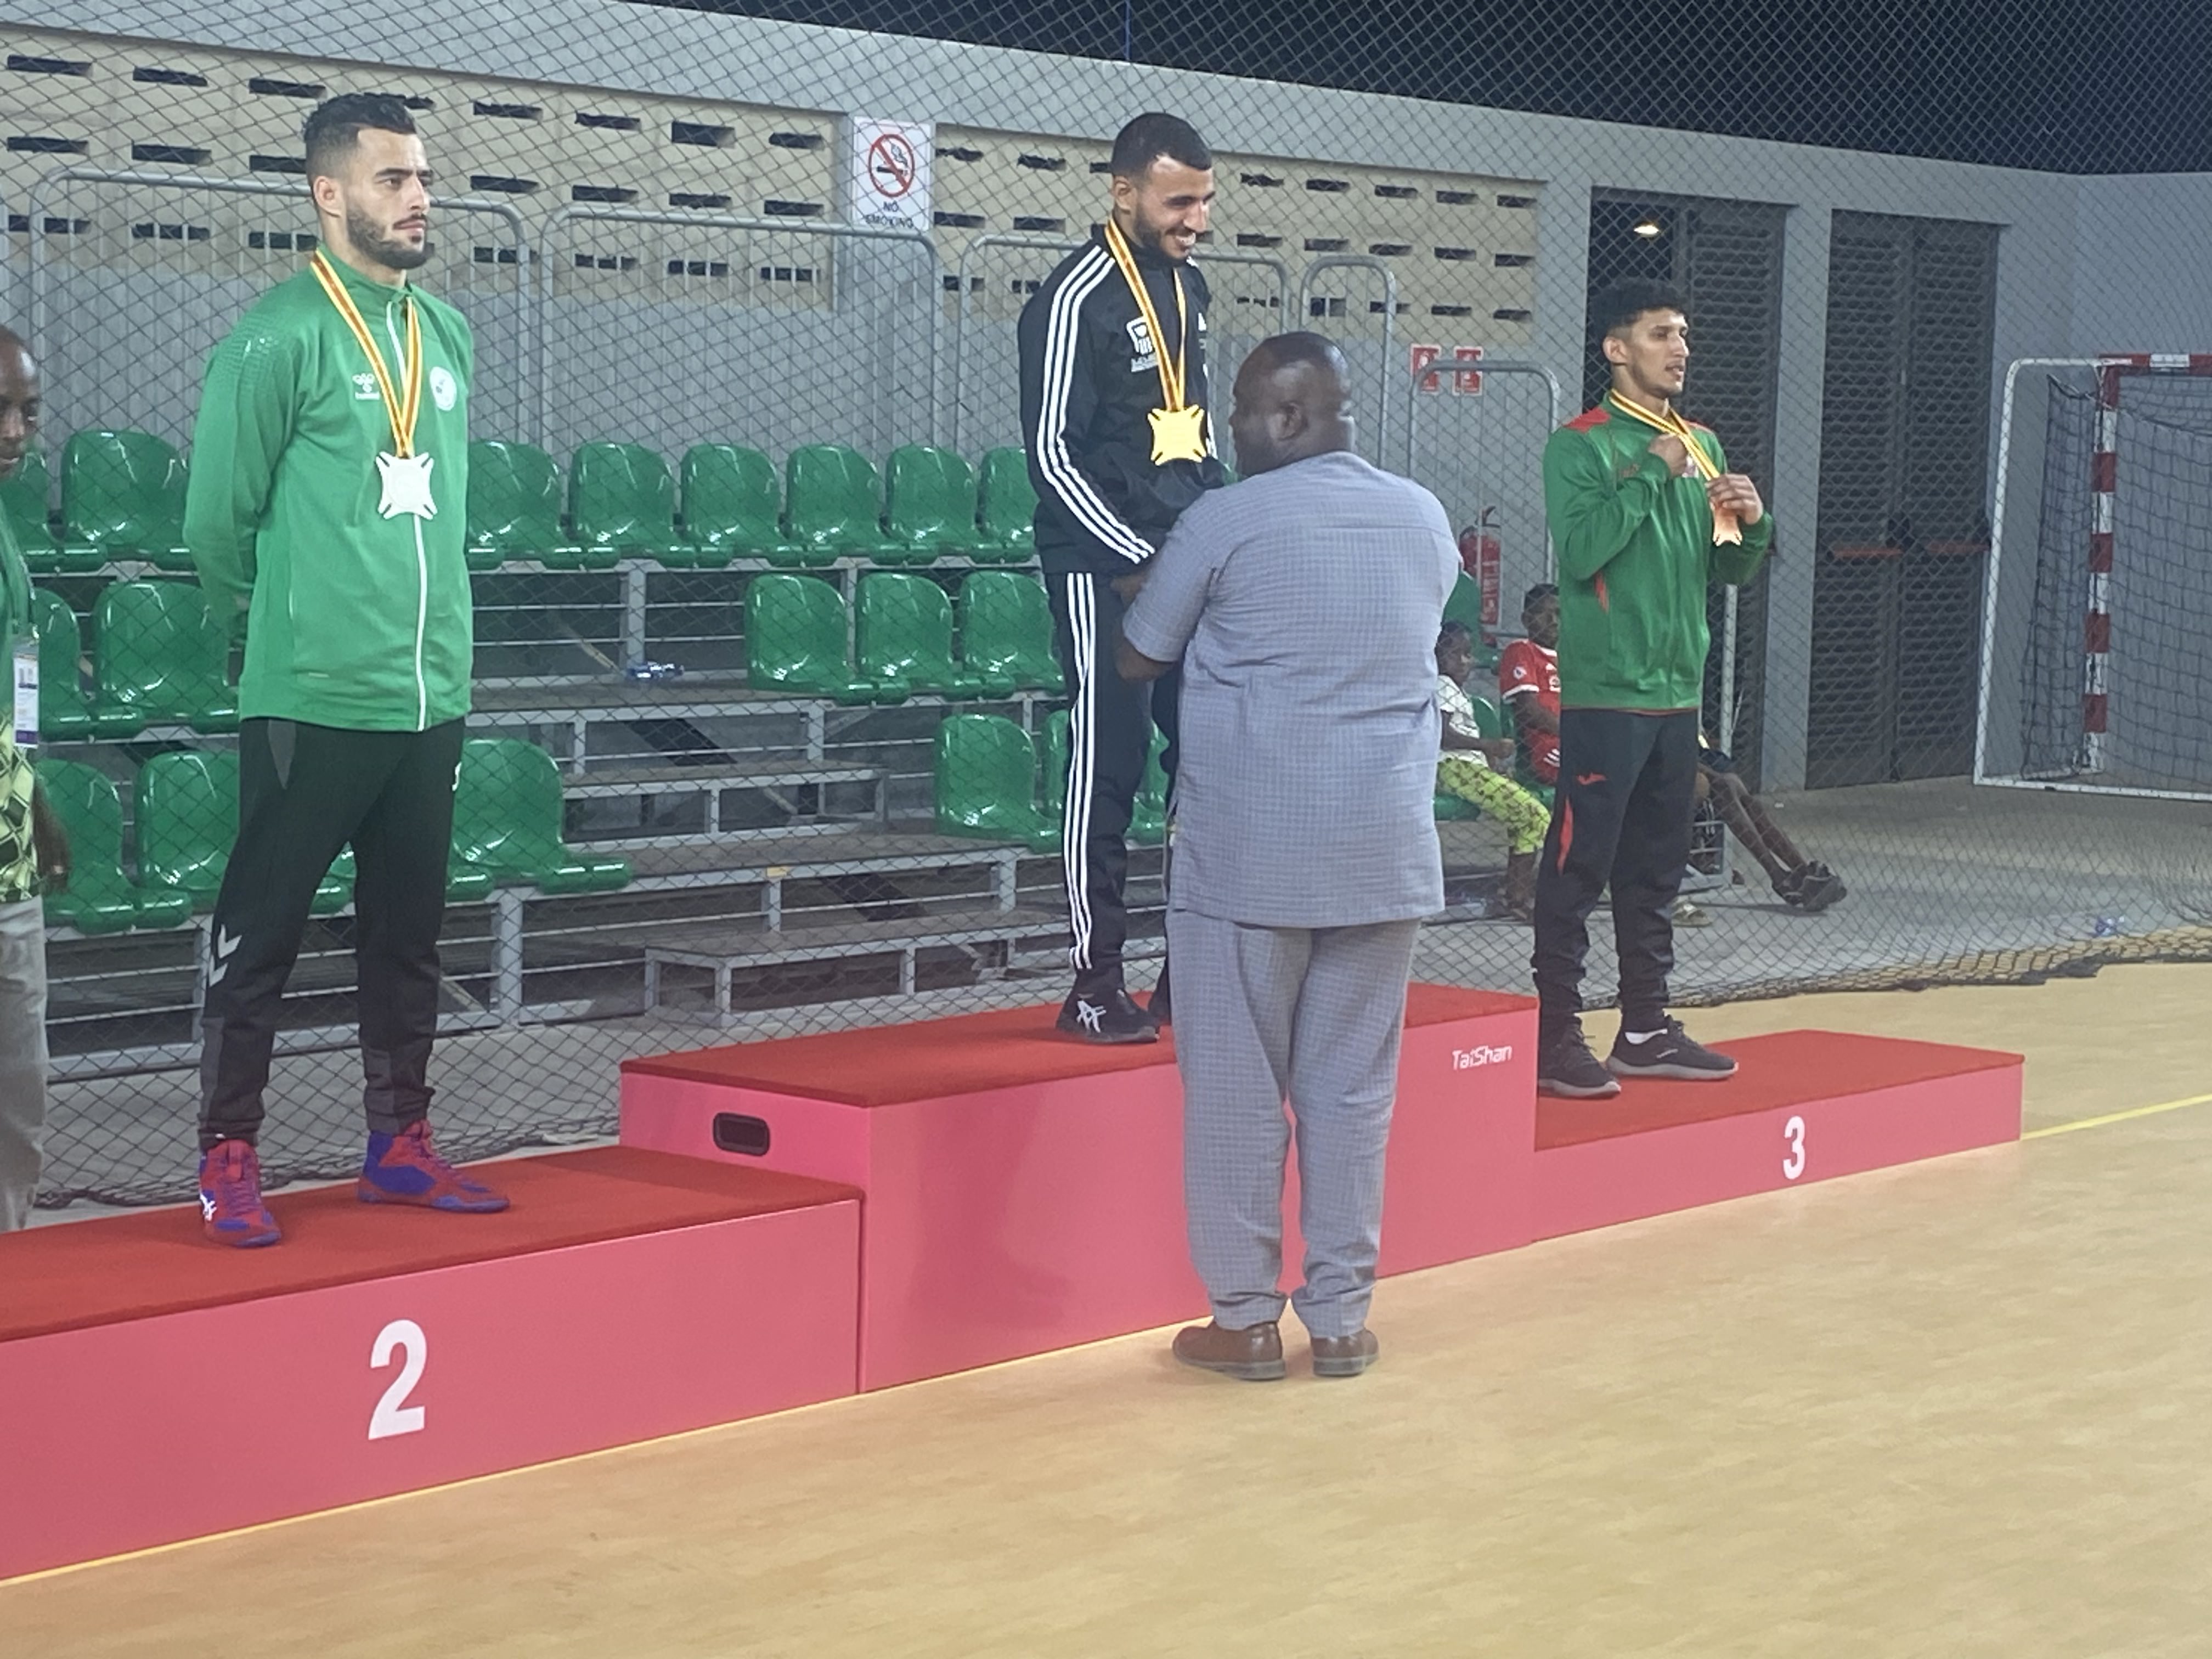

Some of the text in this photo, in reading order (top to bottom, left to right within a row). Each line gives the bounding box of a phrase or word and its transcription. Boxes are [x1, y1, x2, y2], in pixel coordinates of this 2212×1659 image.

[883, 201, 899, 212] NO
[1452, 1045, 1513, 1070] TaiShan
[1783, 1115, 1805, 1180] 3
[368, 1319, 427, 1440] 2
